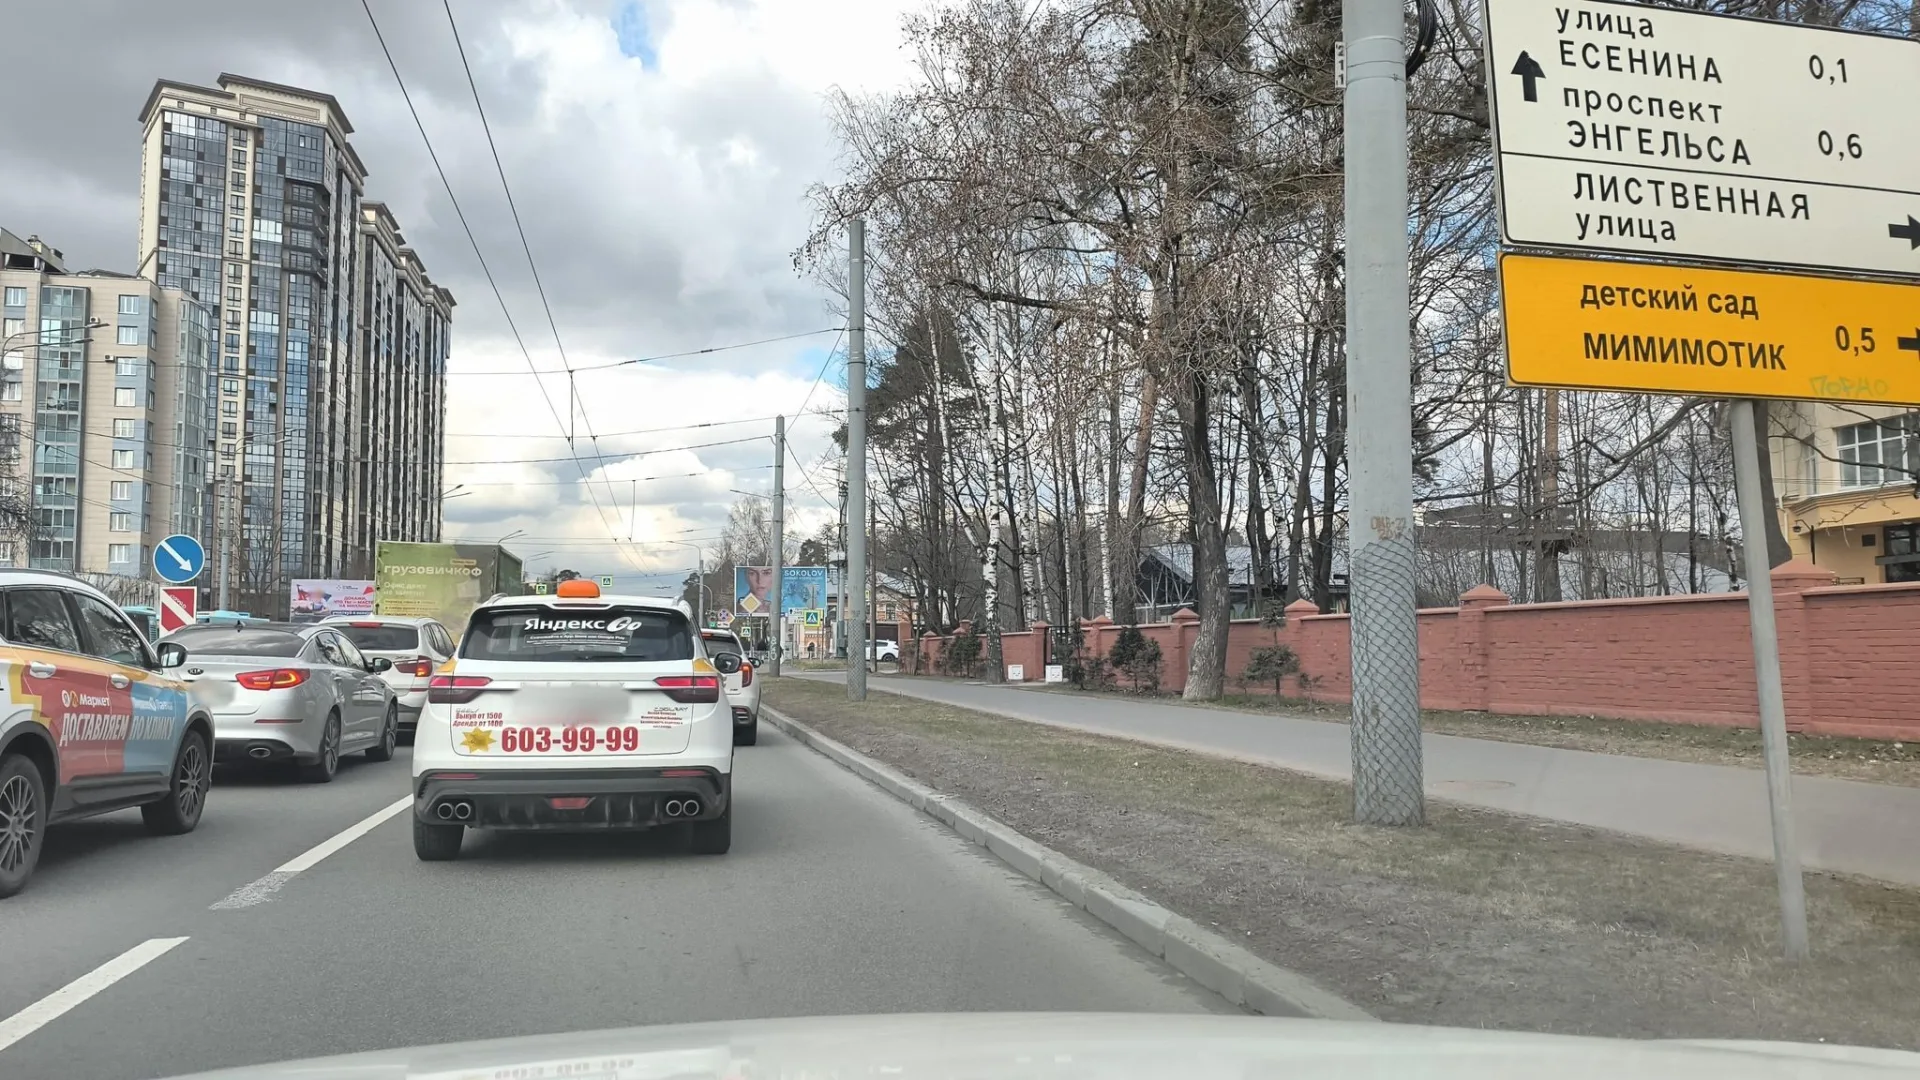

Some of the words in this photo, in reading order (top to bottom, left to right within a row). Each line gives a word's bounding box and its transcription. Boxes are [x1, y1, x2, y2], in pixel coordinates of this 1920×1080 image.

[1555, 7, 1655, 38] улица
[1559, 40, 1723, 83] ЕСЕНИНА
[1808, 54, 1849, 84] 0,1
[1563, 87, 1723, 124] проспект
[1567, 121, 1751, 166] ЭНГЕЛЬСА
[1818, 130, 1863, 160] 0,6
[1573, 173, 1810, 220] ЛИСТВЕННАЯ
[1576, 213, 1676, 243] улица
[1580, 284, 1698, 312] детский
[1707, 292, 1759, 320] сад
[1583, 332, 1787, 370] МИМИМОТИК
[1835, 325, 1876, 357] 0,5
[384, 565, 482, 577] грузовичкоф
[524, 618, 605, 631] Яндекс
[606, 616, 642, 632] Go
[79, 693, 110, 708] Маркет
[59, 712, 130, 747] ДОСТАВЛЯЕМ
[501, 726, 639, 752] 603-99-99
